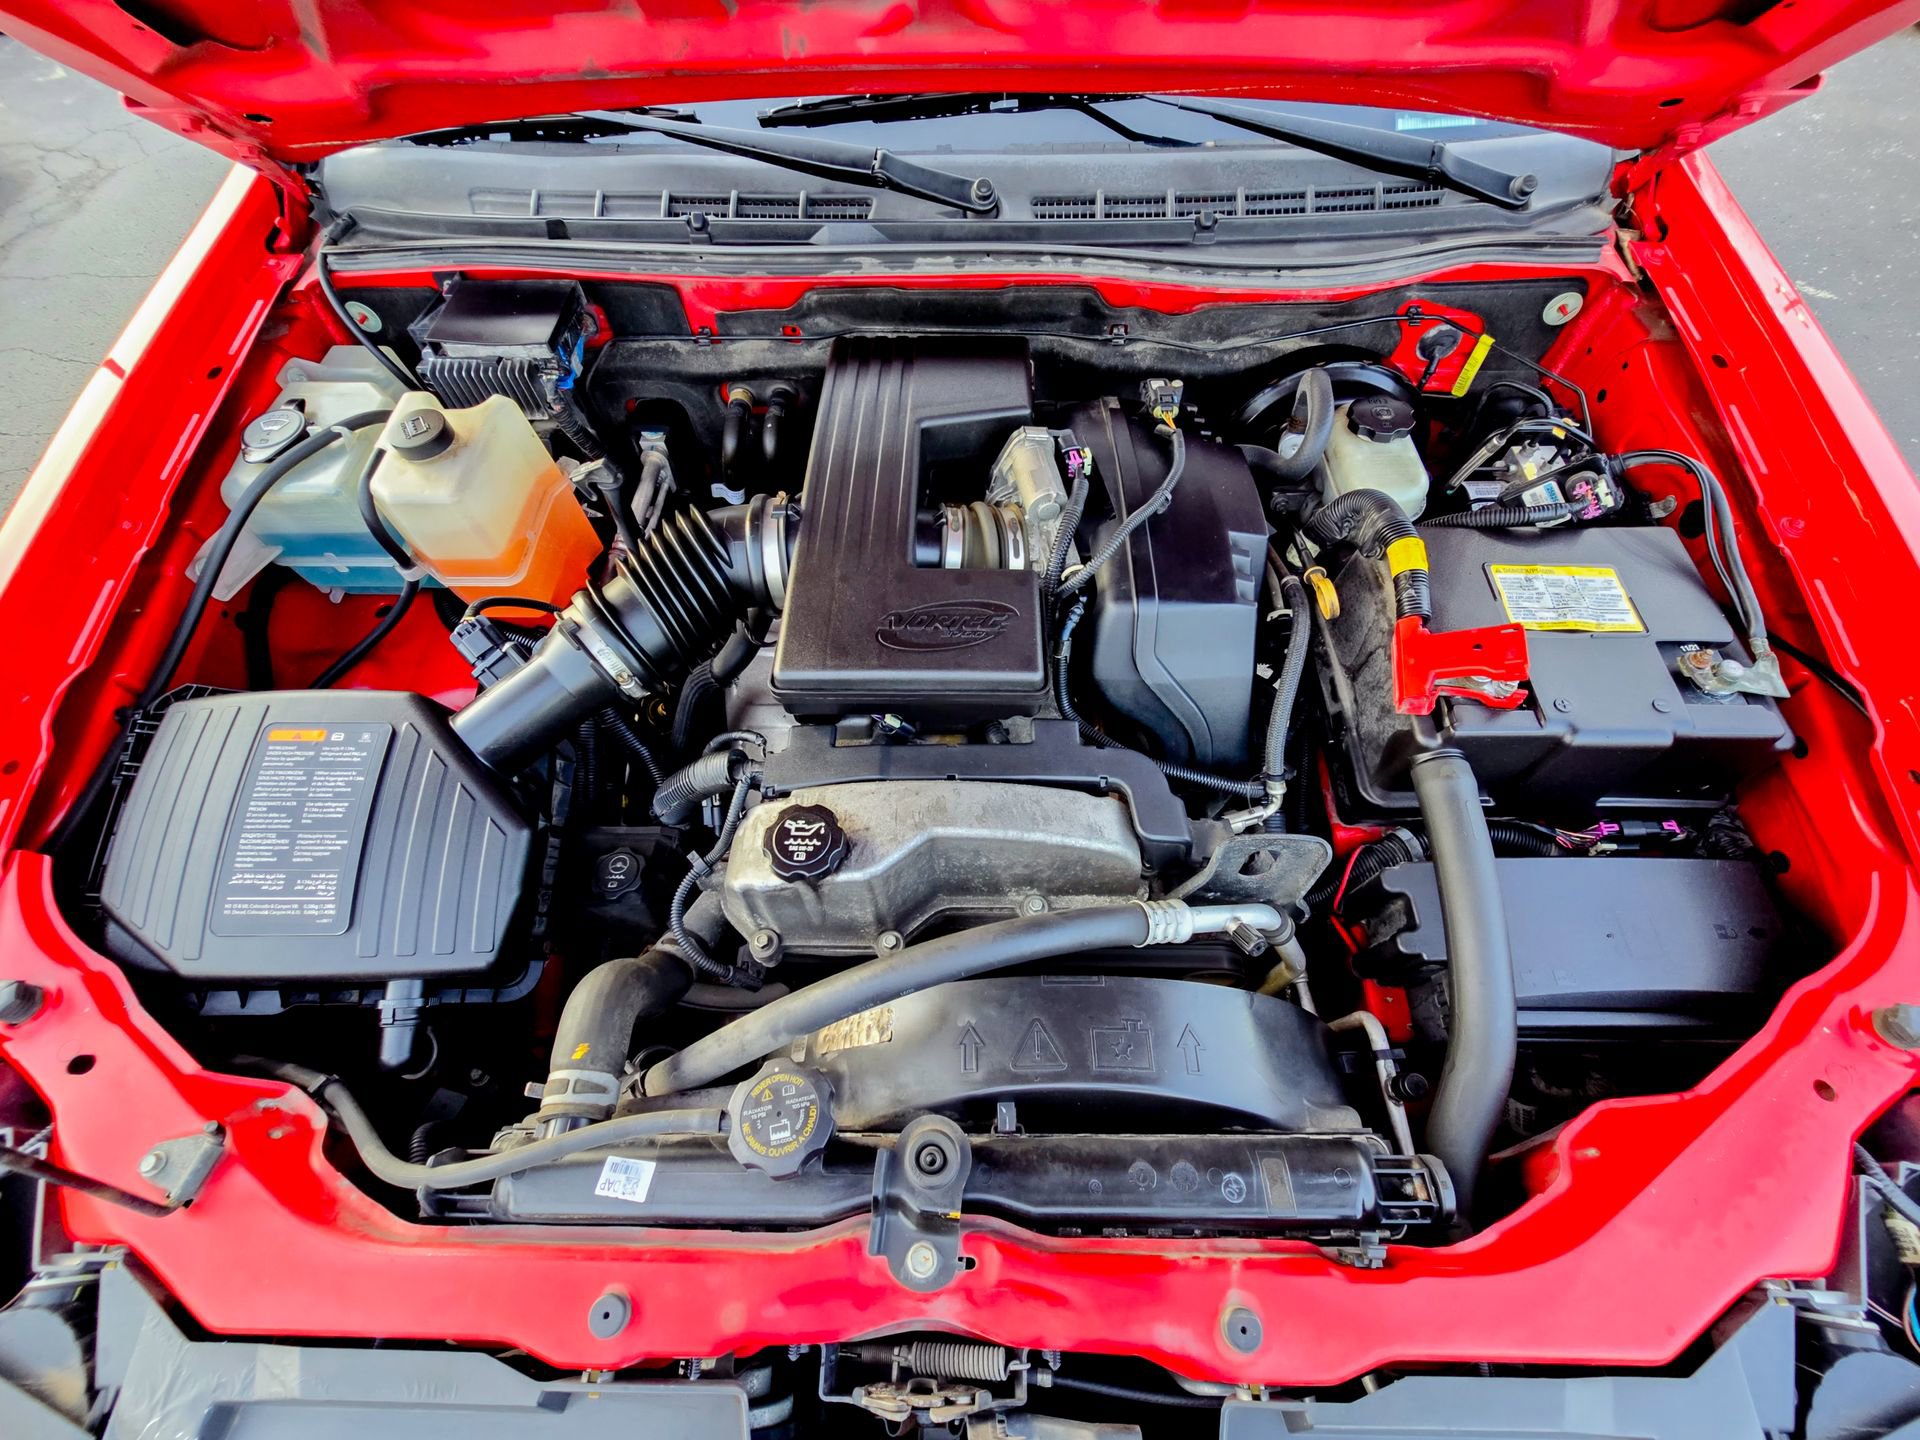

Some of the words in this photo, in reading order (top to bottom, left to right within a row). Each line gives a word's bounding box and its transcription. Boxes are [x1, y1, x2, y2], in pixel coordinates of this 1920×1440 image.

[881, 612, 1009, 631] VORTEC
[1680, 644, 1700, 652] 11/21
[752, 1079, 771, 1098] NEVER
[772, 1074, 789, 1082] OPEN
[790, 1074, 805, 1087] HOT!
[786, 1094, 816, 1105] RADIATEUR
[743, 1105, 773, 1116] RADIATOR
[742, 1122, 752, 1135] NE
[803, 1105, 817, 1137] CHAUD!
[745, 1135, 766, 1154] JAMAIS
[768, 1141, 798, 1157] OUVRIR
[600, 1178, 622, 1193] DAP
